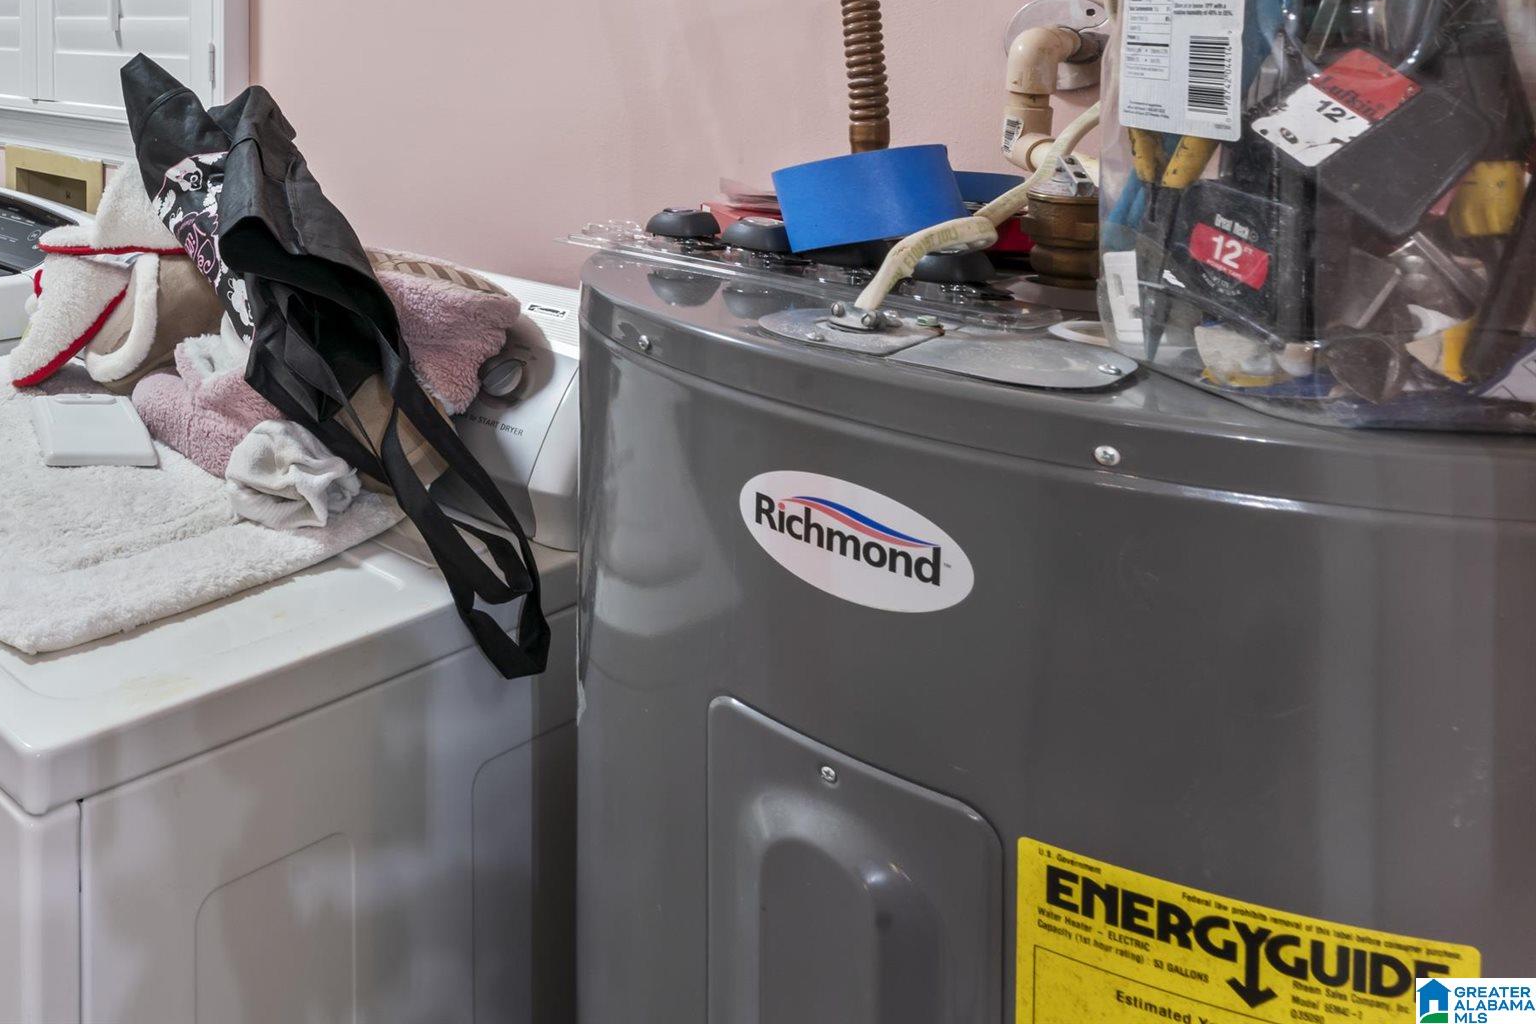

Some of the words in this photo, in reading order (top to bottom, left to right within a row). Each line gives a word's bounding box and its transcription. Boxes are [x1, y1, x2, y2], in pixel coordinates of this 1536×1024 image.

[1212, 235, 1243, 269] 12
[500, 423, 524, 436] DRYER
[755, 491, 941, 587] Richmond
[1056, 853, 1101, 874] Government
[1182, 891, 1212, 907] Federal
[1215, 900, 1229, 911] law
[1232, 905, 1267, 923] prohibits
[1038, 907, 1062, 922] Water
[1065, 916, 1093, 932] Heater
[1108, 931, 1150, 952] ELECTRIC
[1037, 919, 1072, 940] Capacity
[1093, 939, 1112, 953] hour
[1167, 963, 1210, 983] GALLONS
[1115, 989, 1192, 1024] Estimated
